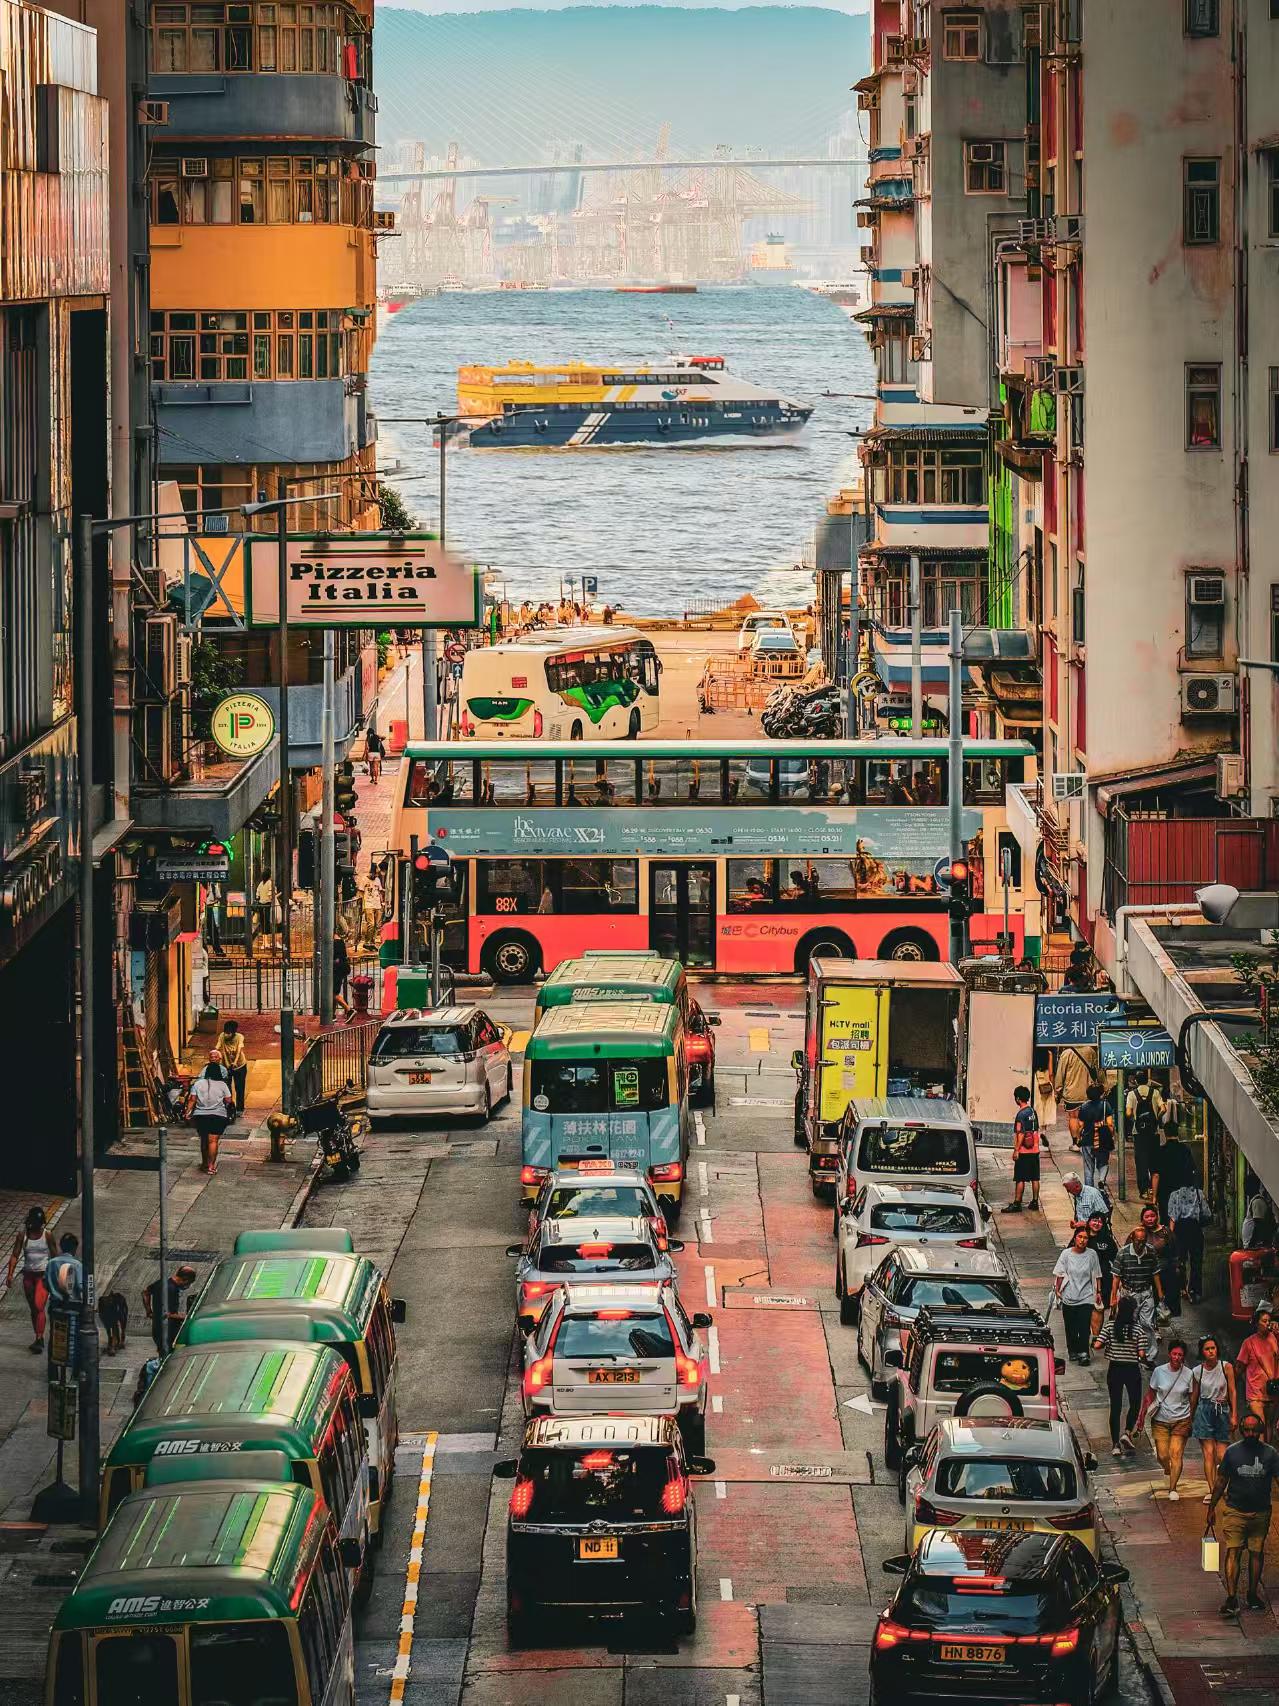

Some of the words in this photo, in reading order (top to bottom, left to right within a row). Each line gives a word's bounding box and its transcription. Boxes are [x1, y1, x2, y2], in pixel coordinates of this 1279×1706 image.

[290, 562, 437, 580] Pizzeria
[308, 583, 419, 600] Italia
[584, 577, 595, 592] P
[225, 701, 259, 712] PIZZERIA
[229, 741, 256, 750] ITALIA
[496, 897, 517, 912] 88X
[760, 925, 799, 936] Citybus
[851, 1029, 869, 1039] 招聘
[1104, 1050, 1134, 1067] 洗衣
[1136, 1051, 1171, 1066] LAUNDRY
[563, 1120, 637, 1135] 薄扶林花園
[595, 1373, 609, 1382] AX
[613, 1373, 635, 1383] 1213
[154, 1440, 201, 1455] AMS
[585, 1542, 601, 1553] ND
[107, 1596, 162, 1615] AMS
[944, 1647, 962, 1659] HN
[967, 1648, 1002, 1660] 8876
